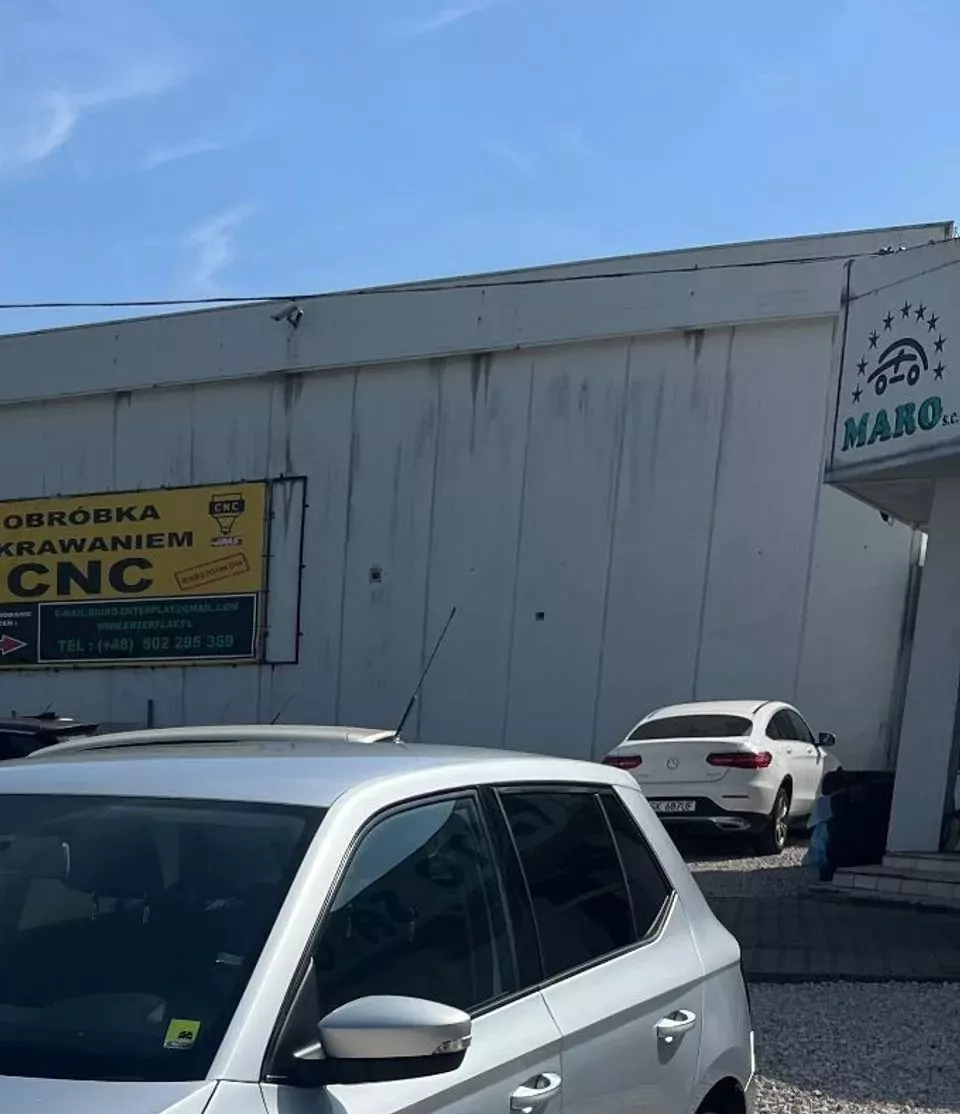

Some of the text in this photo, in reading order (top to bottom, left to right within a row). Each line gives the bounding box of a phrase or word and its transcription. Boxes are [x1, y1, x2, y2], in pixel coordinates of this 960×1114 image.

[841, 396, 943, 451] MARO
[2, 504, 161, 530] OBRÓBKA
[213, 502, 241, 513] CNC
[7, 557, 154, 598] CNC
